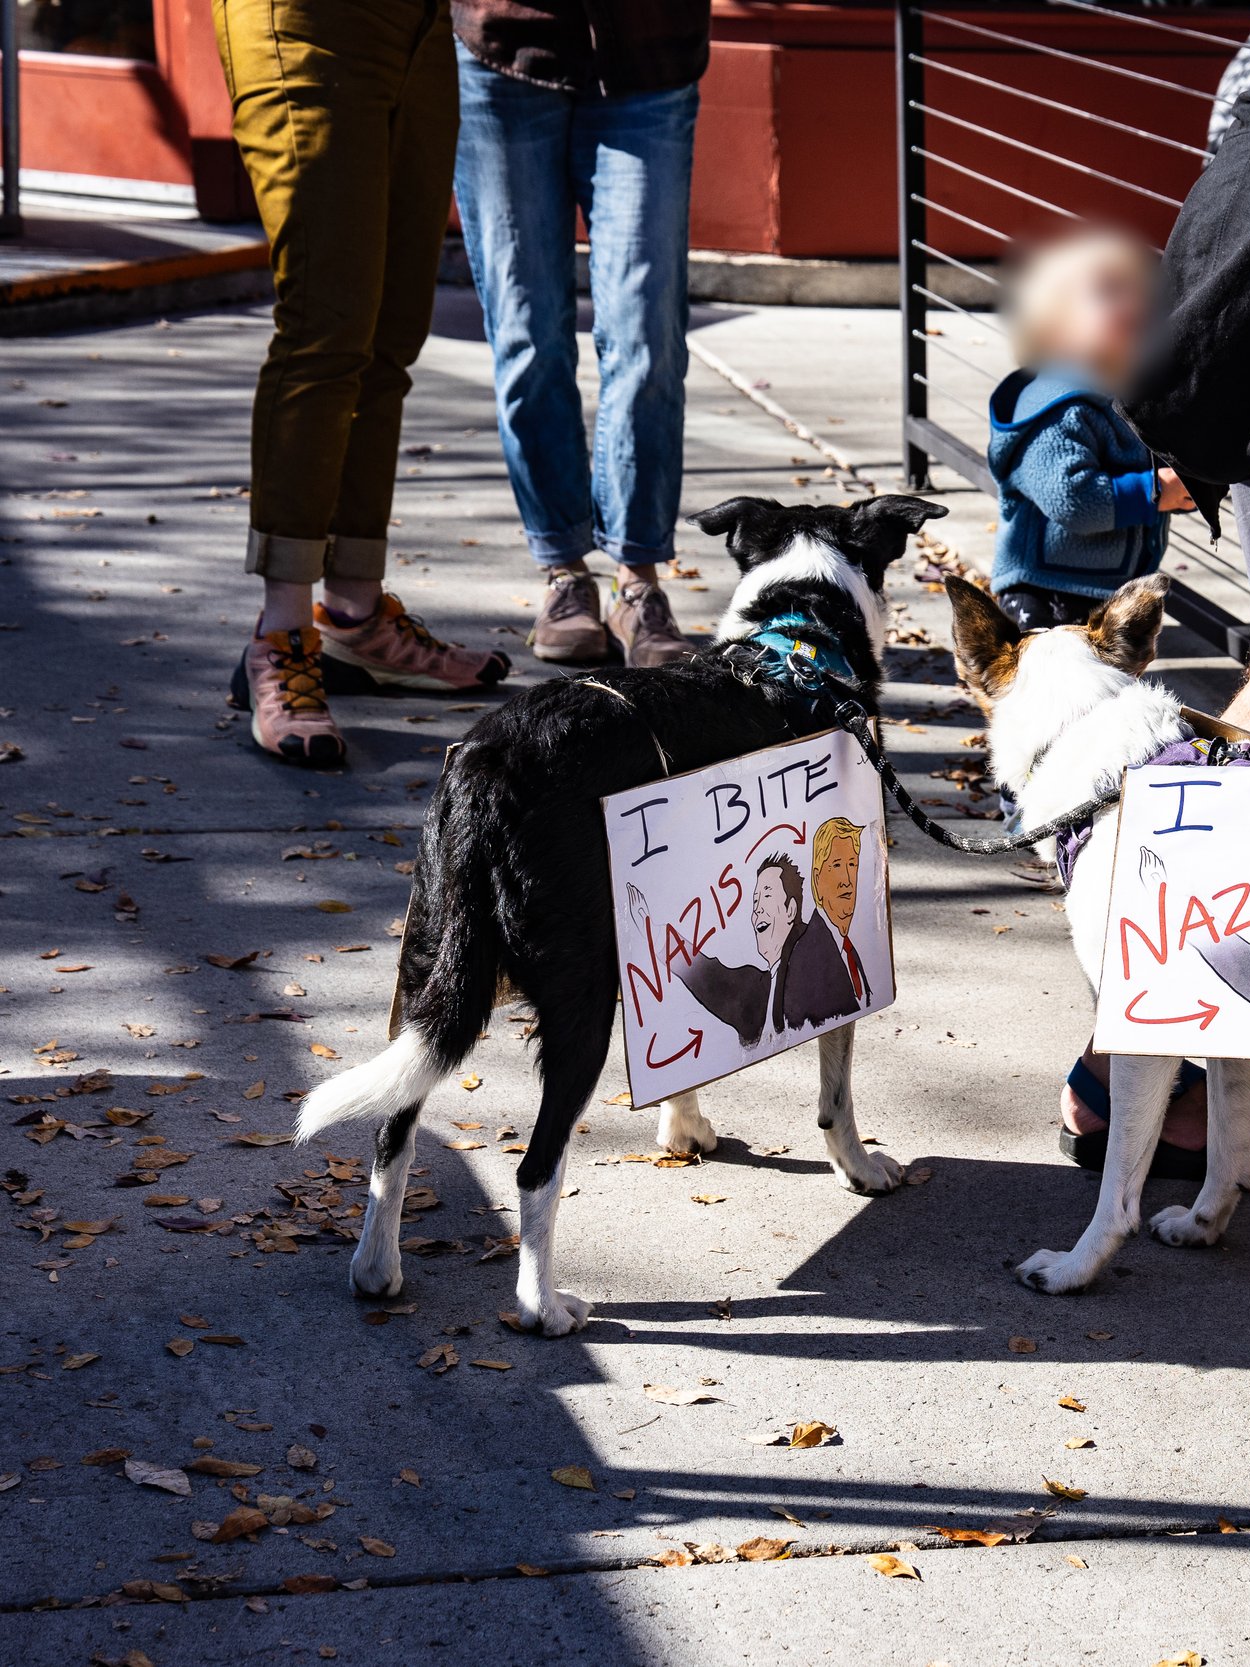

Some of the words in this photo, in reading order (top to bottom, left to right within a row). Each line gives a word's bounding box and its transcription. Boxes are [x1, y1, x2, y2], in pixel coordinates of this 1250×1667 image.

[620, 797, 669, 867] I
[704, 753, 839, 844] BITE
[1149, 780, 1222, 834] I
[626, 863, 743, 1028] NAZIS
